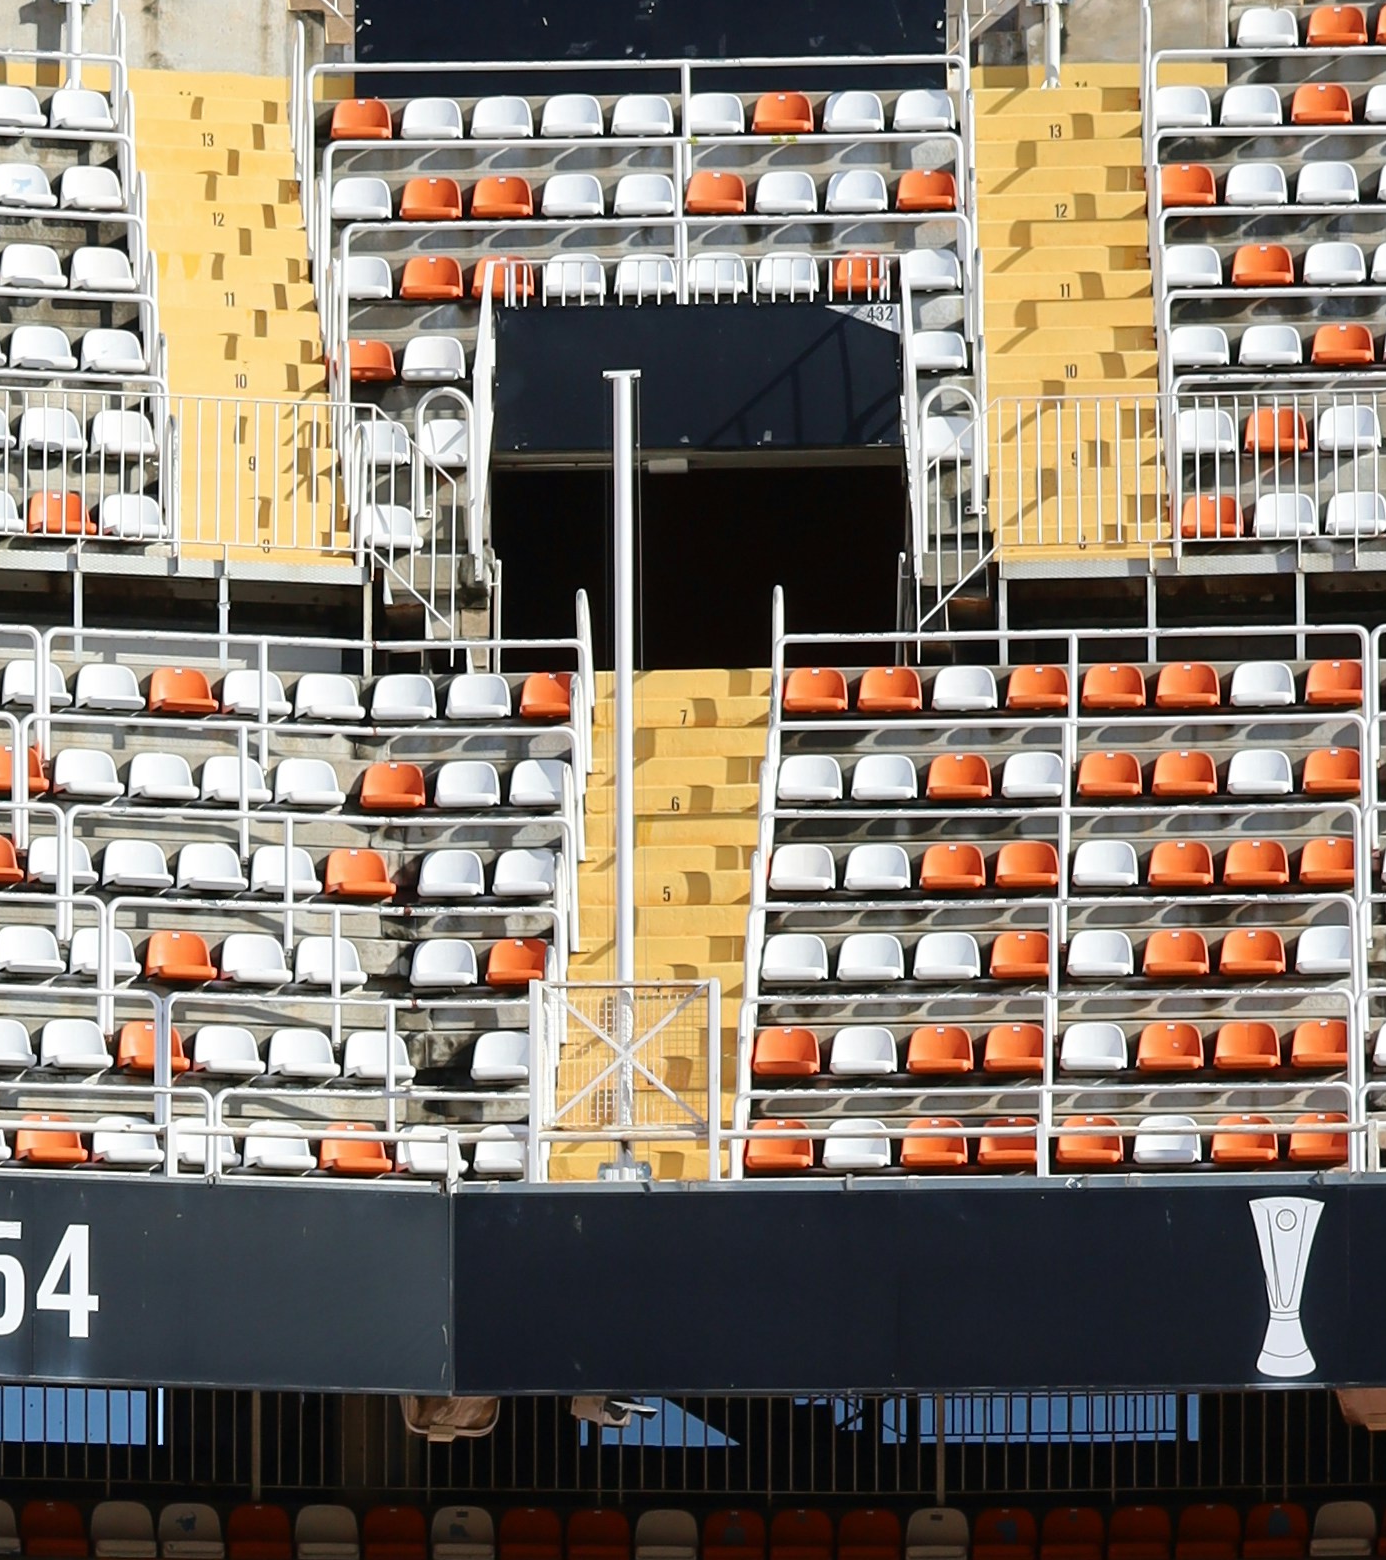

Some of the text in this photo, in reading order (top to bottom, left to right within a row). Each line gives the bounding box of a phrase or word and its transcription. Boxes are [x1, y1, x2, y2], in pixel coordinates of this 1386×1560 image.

[1048, 124, 1062, 139] 13
[202, 133, 214, 147] 13
[212, 211, 225, 227] 12
[1054, 203, 1067, 219] 12
[1059, 283, 1071, 298] 11
[224, 292, 235, 306] 11
[866, 306, 893, 323] 432
[1065, 363, 1078, 379] 10
[234, 373, 248, 389] 10
[248, 456, 256, 471] 9
[680, 710, 688, 726] 7
[671, 795, 680, 812] 6
[663, 886, 671, 902] 5
